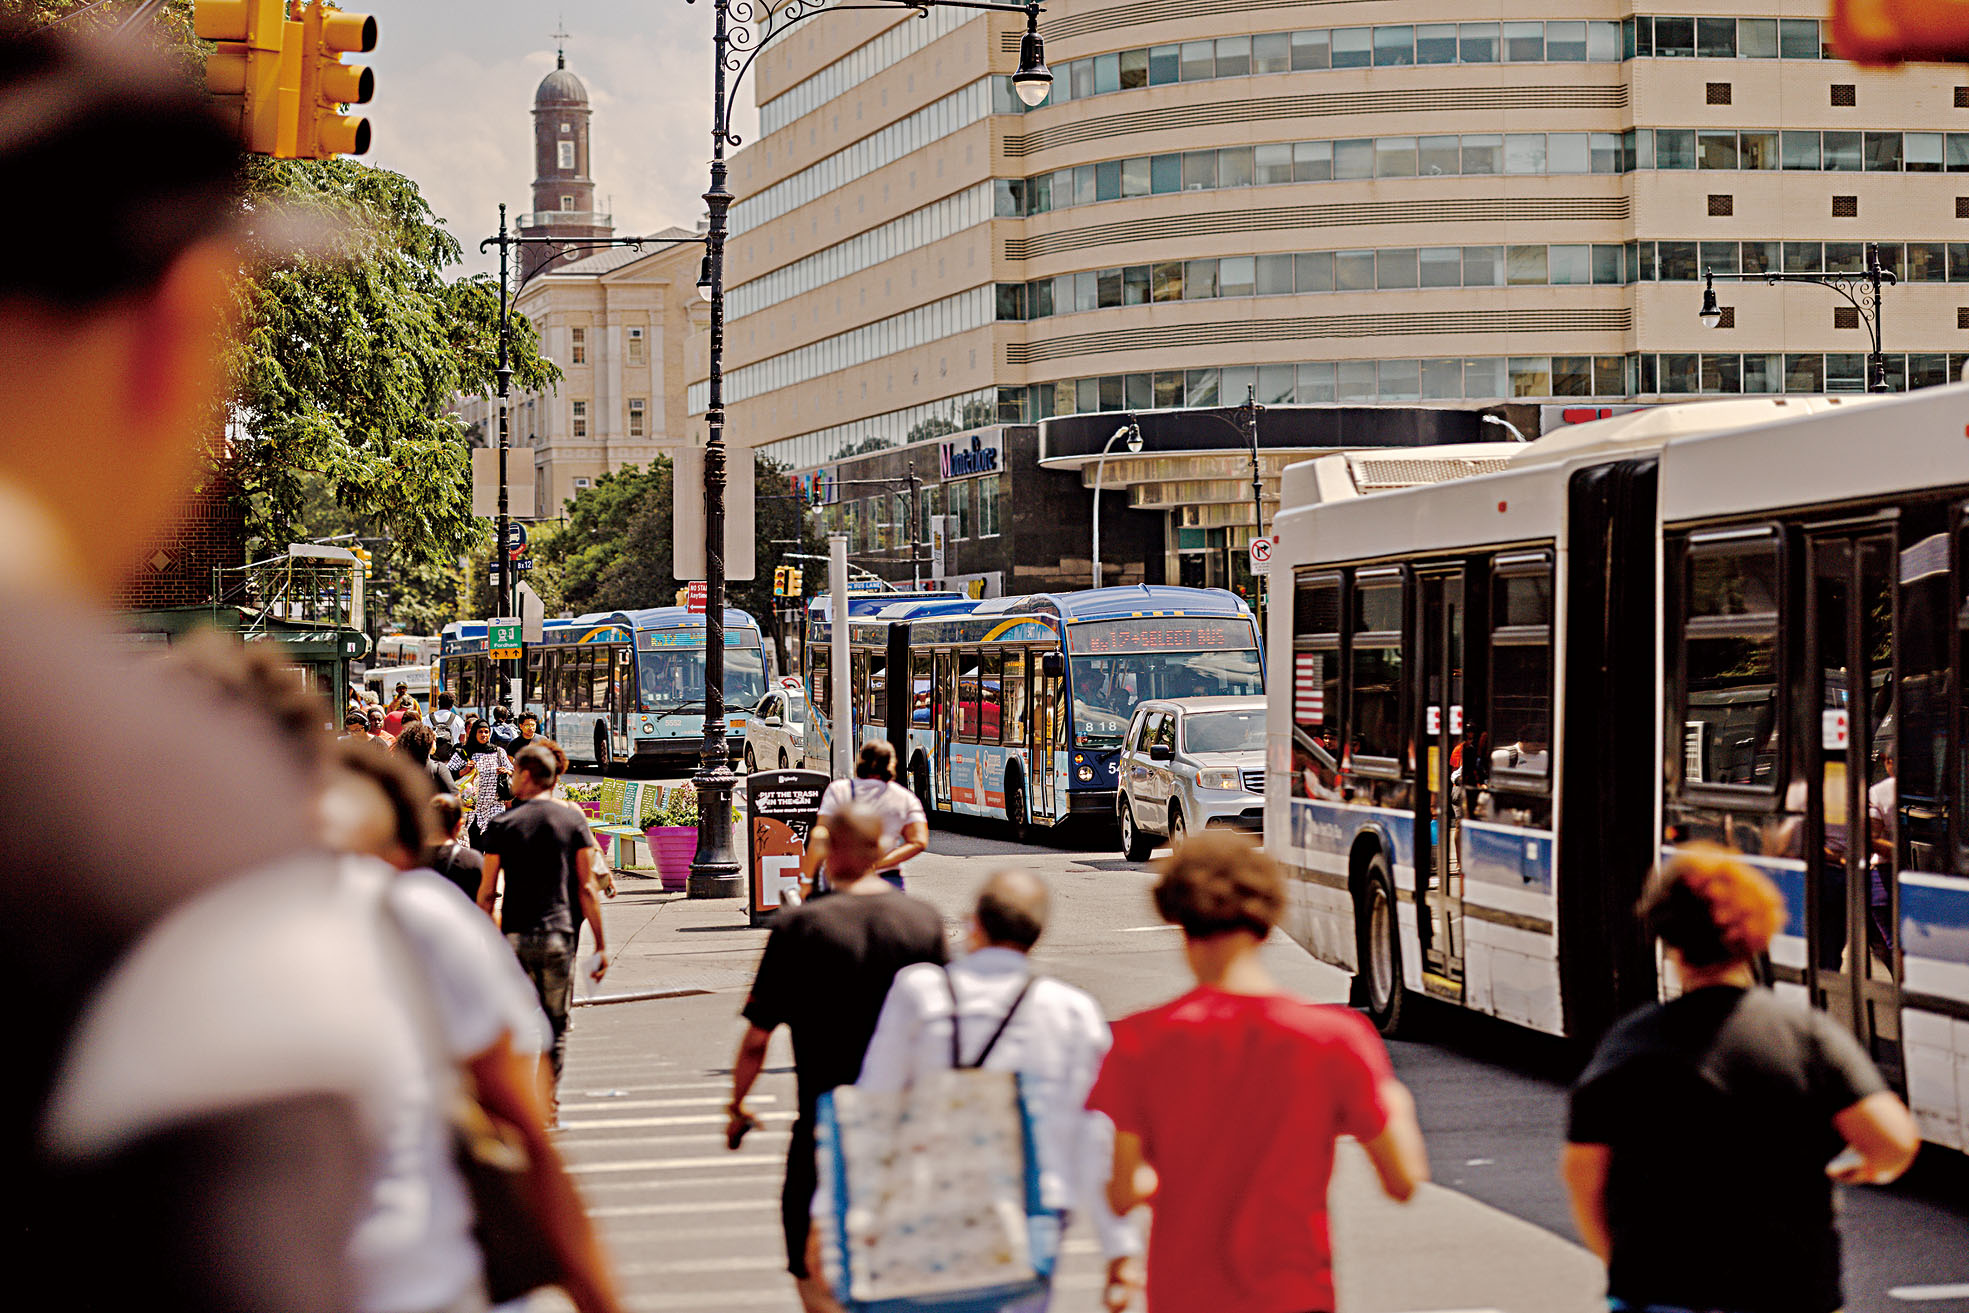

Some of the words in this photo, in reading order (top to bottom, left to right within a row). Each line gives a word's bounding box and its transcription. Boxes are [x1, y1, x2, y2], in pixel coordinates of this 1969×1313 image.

[941, 436, 997, 478] Montefiore
[1198, 628, 1225, 645] BUS
[793, 790, 819, 798] TRASH
